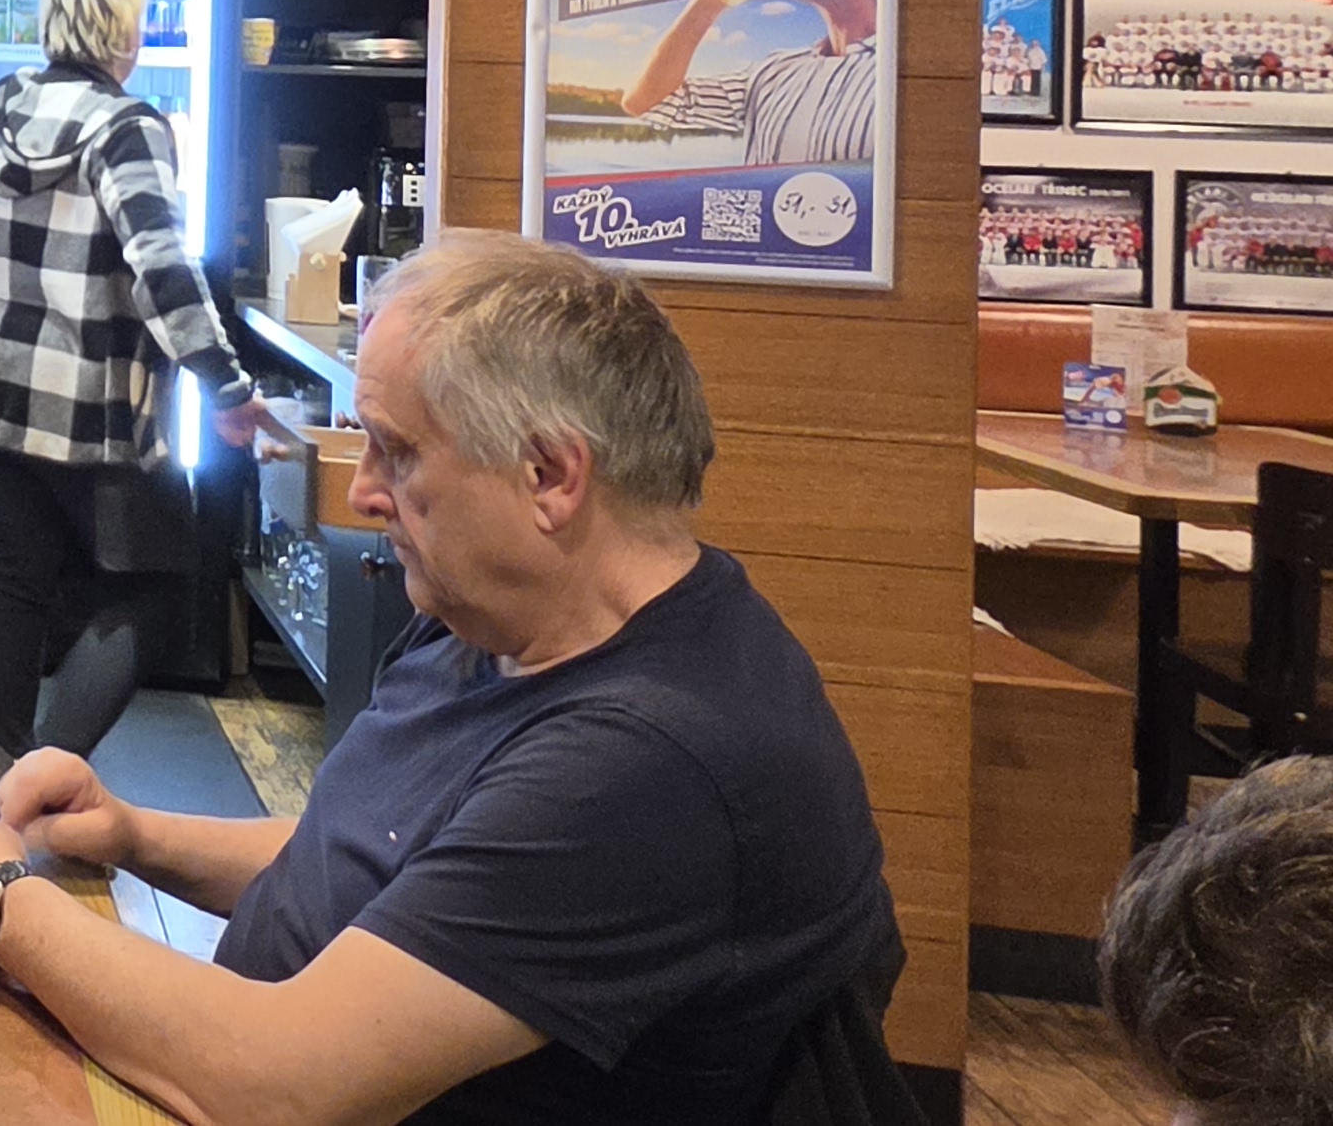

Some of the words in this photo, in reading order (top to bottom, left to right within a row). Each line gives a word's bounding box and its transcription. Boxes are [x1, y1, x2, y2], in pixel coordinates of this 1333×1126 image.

[555, 187, 610, 211] KAŽDÝ
[577, 203, 635, 238] 10.
[606, 217, 684, 247] VYHRÁVÁ
